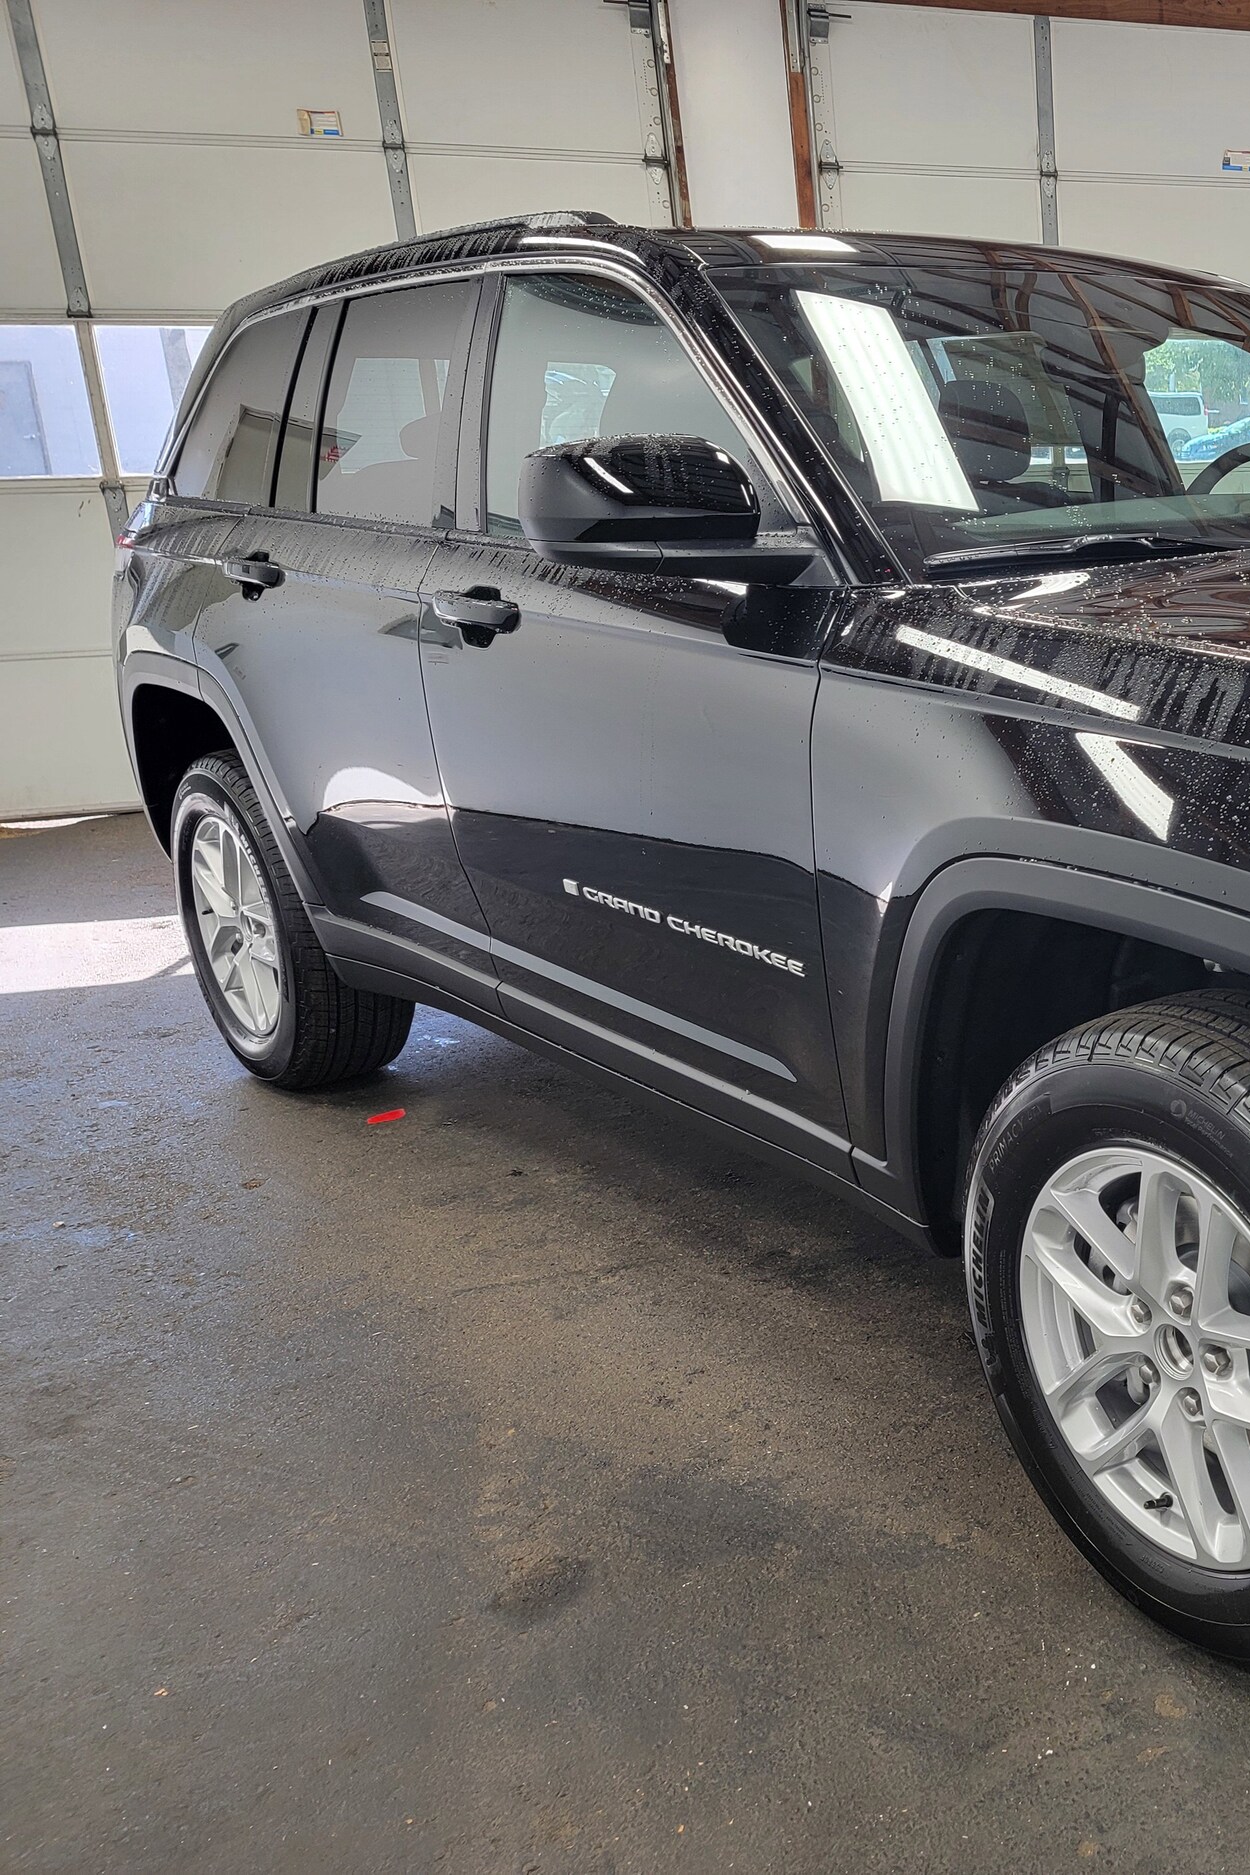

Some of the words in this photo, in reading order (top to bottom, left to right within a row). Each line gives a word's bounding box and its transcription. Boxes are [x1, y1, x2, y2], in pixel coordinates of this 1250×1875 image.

[583, 886, 662, 924] GRAND
[666, 915, 806, 977] CHEROKEE
[988, 1116, 1024, 1175] PRIMACY
[1187, 1109, 1226, 1140] MICHELIN
[971, 1186, 990, 1330] MICHELIN
